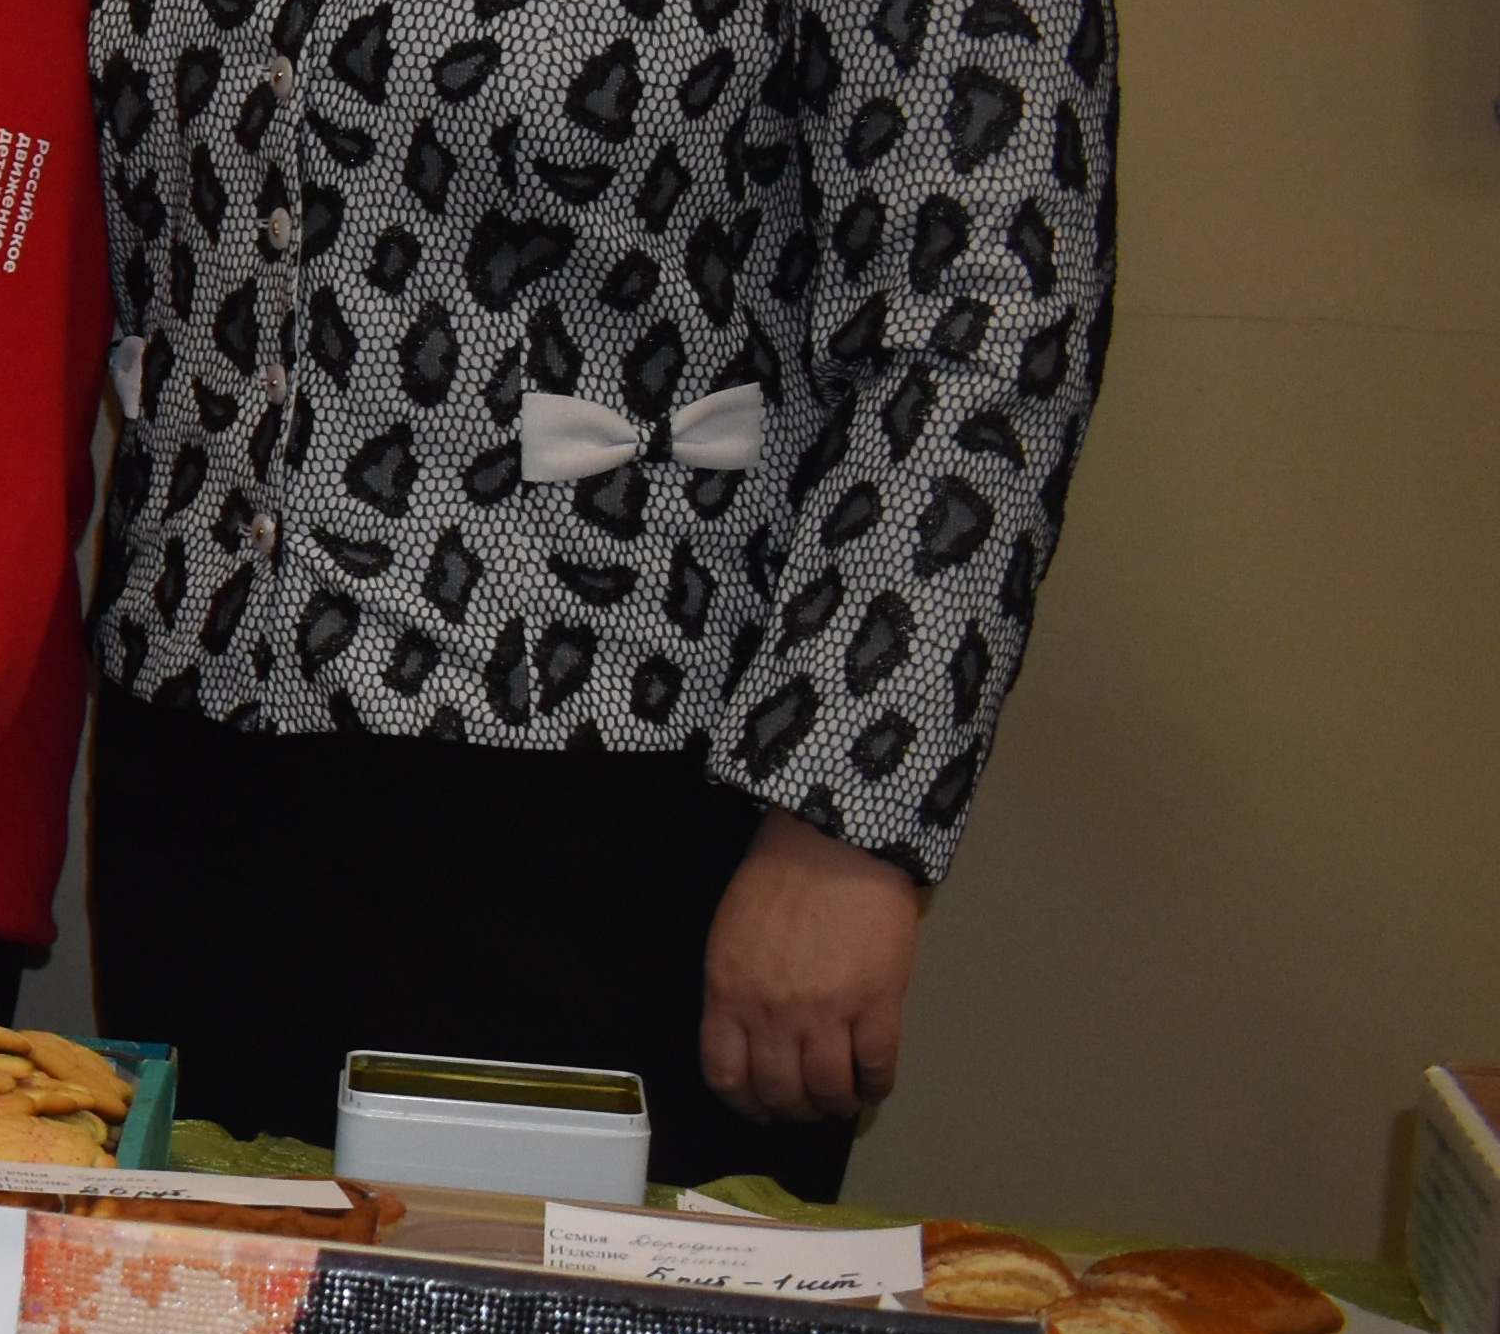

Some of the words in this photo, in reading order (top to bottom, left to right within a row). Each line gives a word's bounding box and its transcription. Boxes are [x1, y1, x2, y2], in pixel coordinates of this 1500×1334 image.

[3, 138, 51, 274] Российское
[550, 1227, 608, 1244] Семья
[550, 1244, 629, 1261] Изделие
